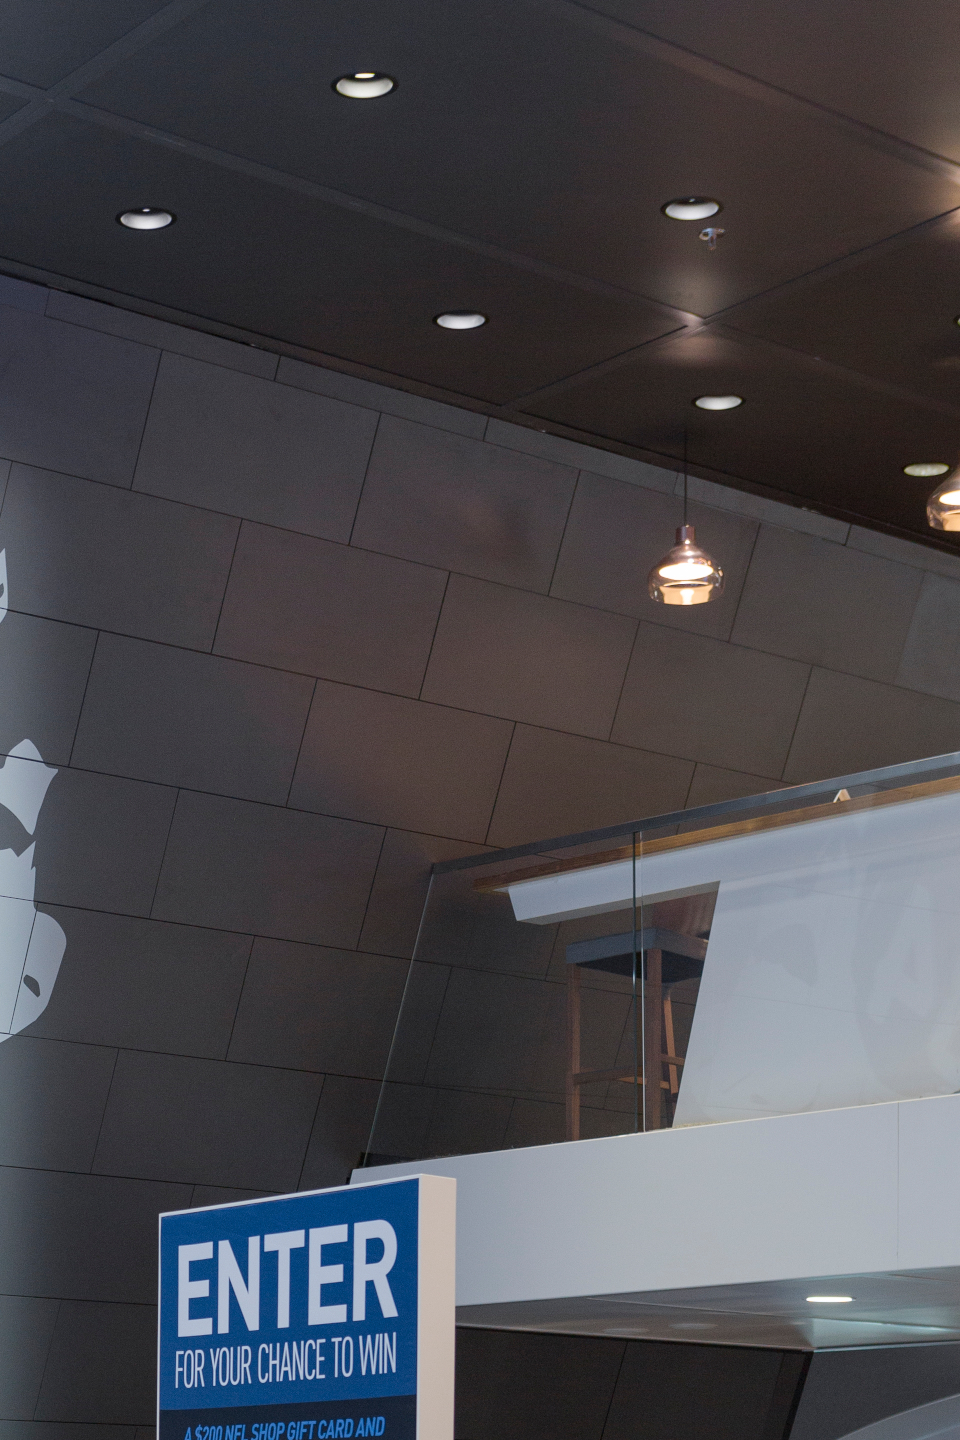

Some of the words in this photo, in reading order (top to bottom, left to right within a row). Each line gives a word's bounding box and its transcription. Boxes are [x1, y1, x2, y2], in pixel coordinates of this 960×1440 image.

[177, 1219, 399, 1338] ENTER
[175, 1350, 205, 1389] FOR
[210, 1346, 252, 1387] YOUR
[257, 1339, 326, 1384] CHANCE
[331, 1336, 354, 1378] TO
[359, 1332, 397, 1376] WIN
[286, 1420, 317, 1440] GIFT
[317, 1418, 354, 1440] CARD
[355, 1416, 386, 1437] AND
